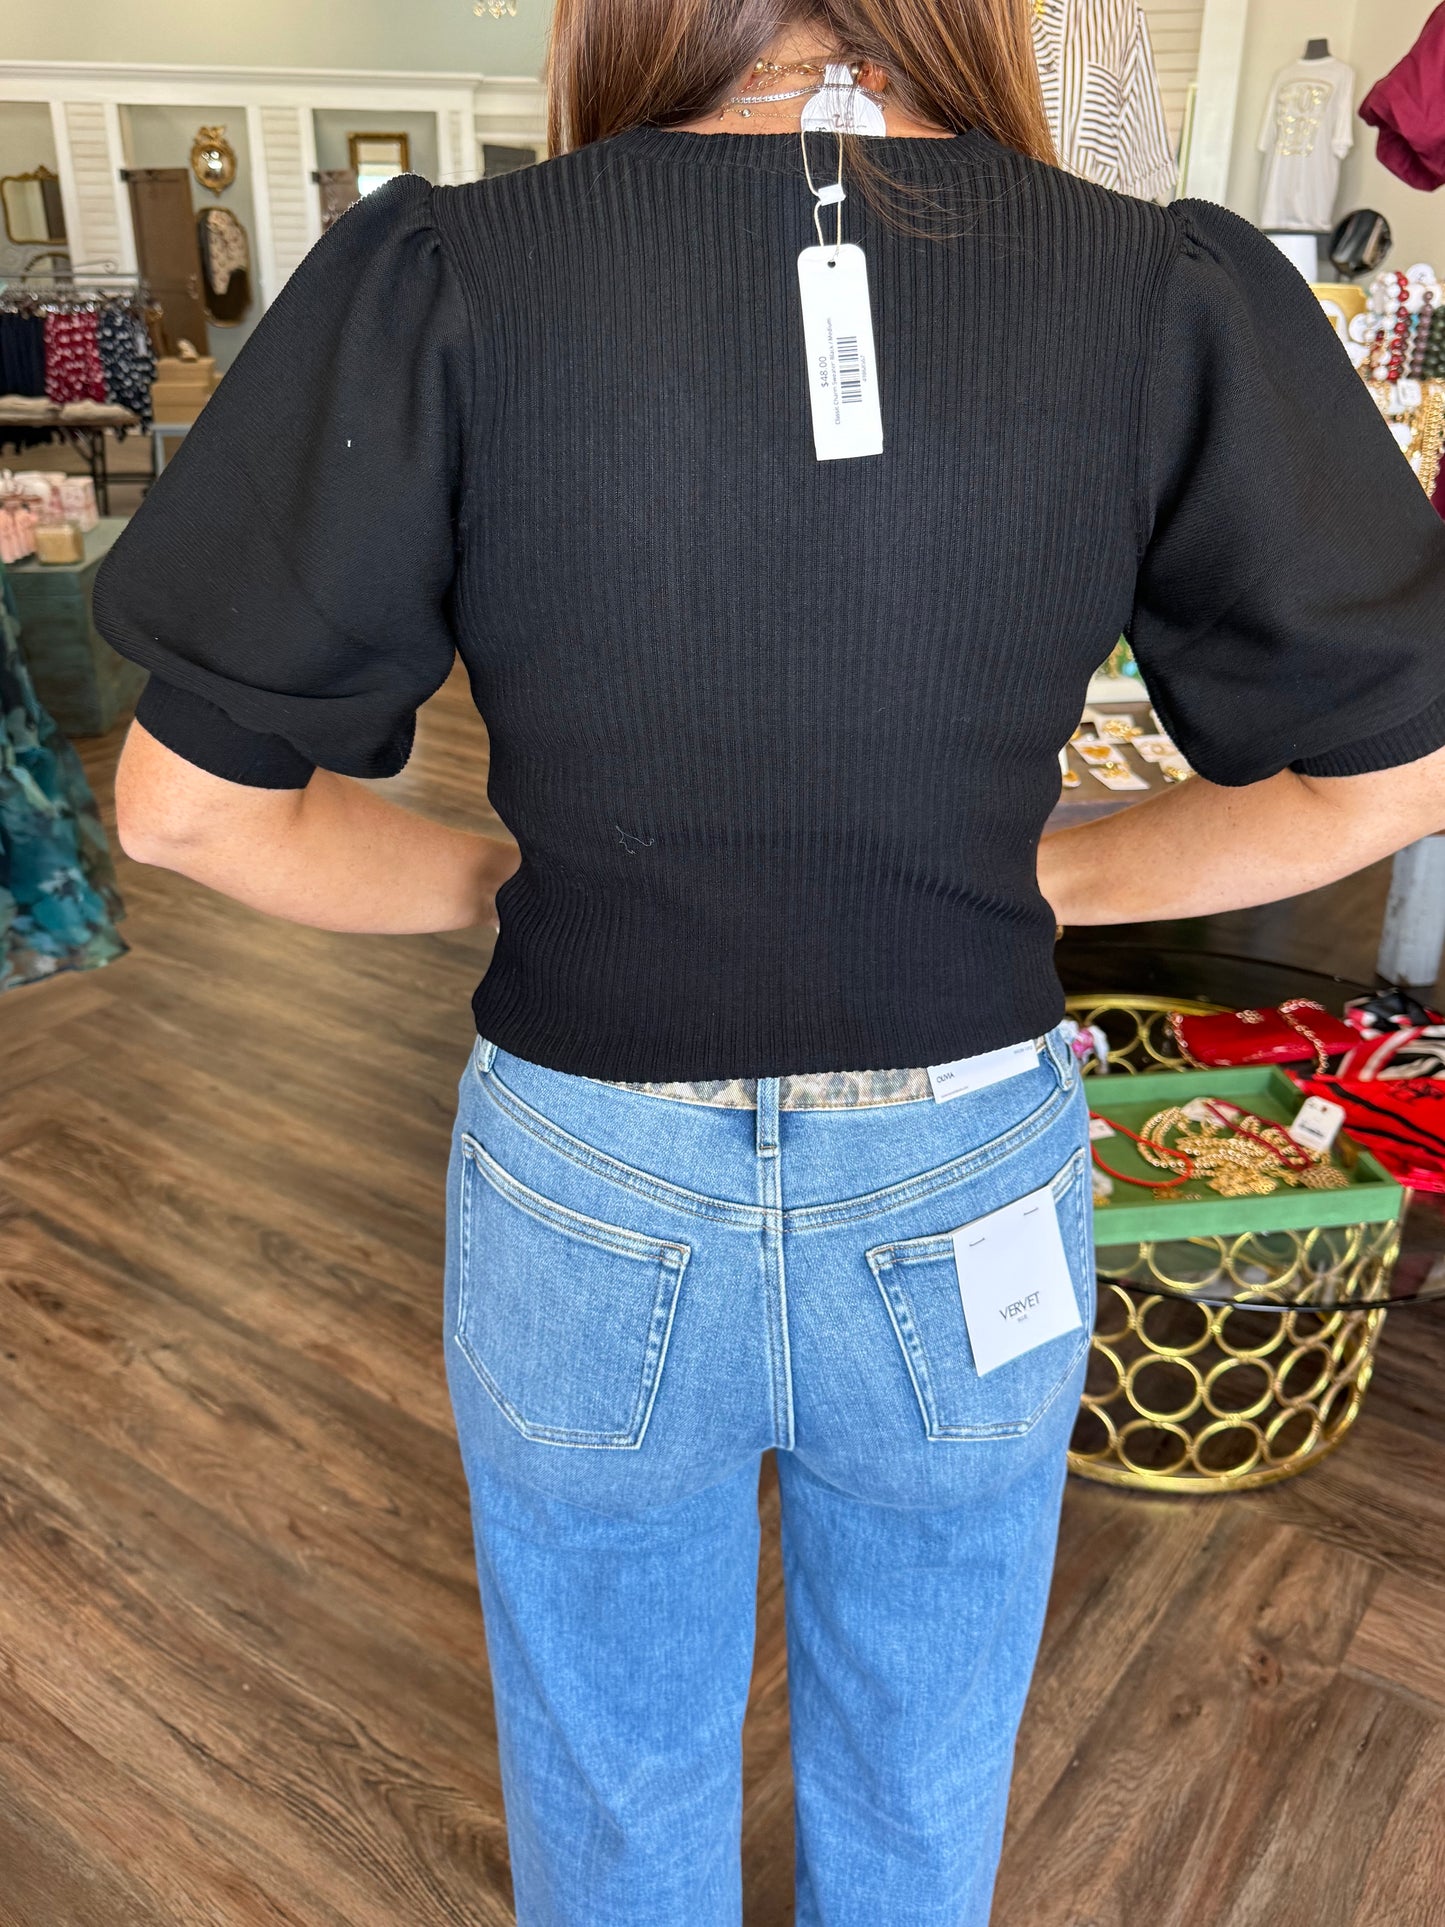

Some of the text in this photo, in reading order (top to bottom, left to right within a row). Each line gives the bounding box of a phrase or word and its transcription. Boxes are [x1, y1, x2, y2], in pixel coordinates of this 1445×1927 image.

[819, 356, 829, 388] $48.00
[830, 363, 838, 385] Sweater
[999, 1291, 1040, 1320] VERVET
